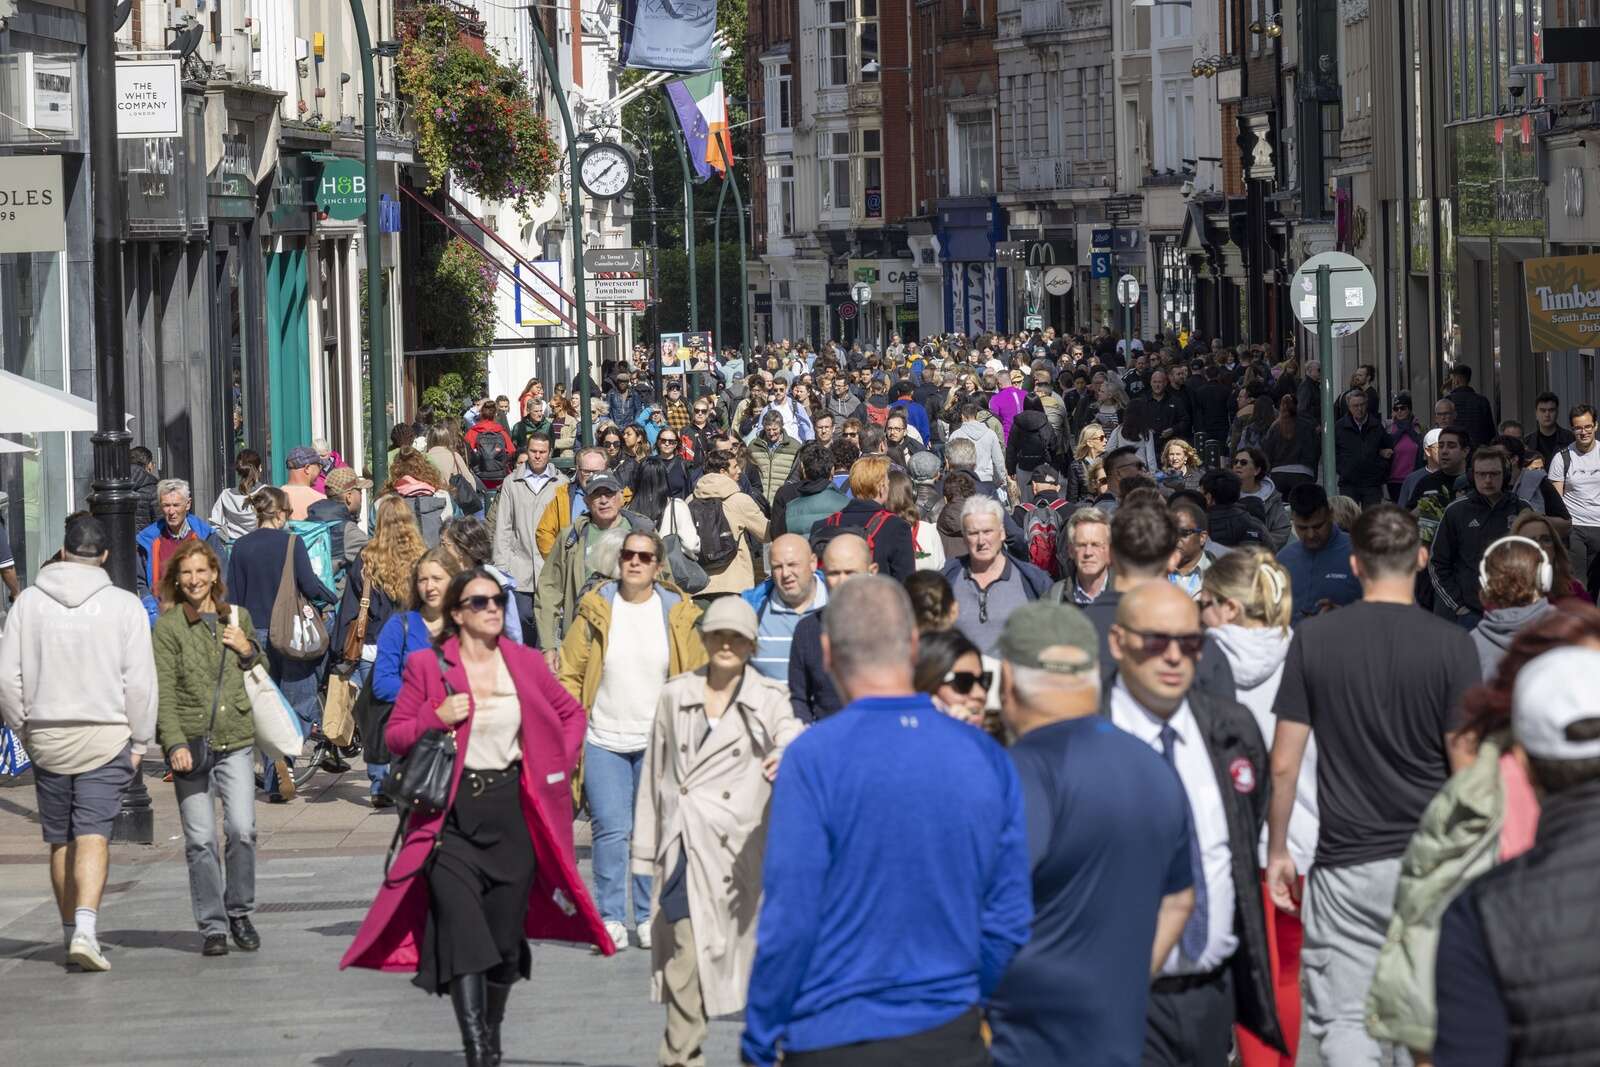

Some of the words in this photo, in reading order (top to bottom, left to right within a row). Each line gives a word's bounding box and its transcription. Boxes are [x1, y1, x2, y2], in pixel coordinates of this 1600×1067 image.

[133, 82, 152, 90] THE
[125, 92, 158, 100] WHITE
[117, 101, 168, 110] COMPANY
[322, 176, 366, 195] H&B
